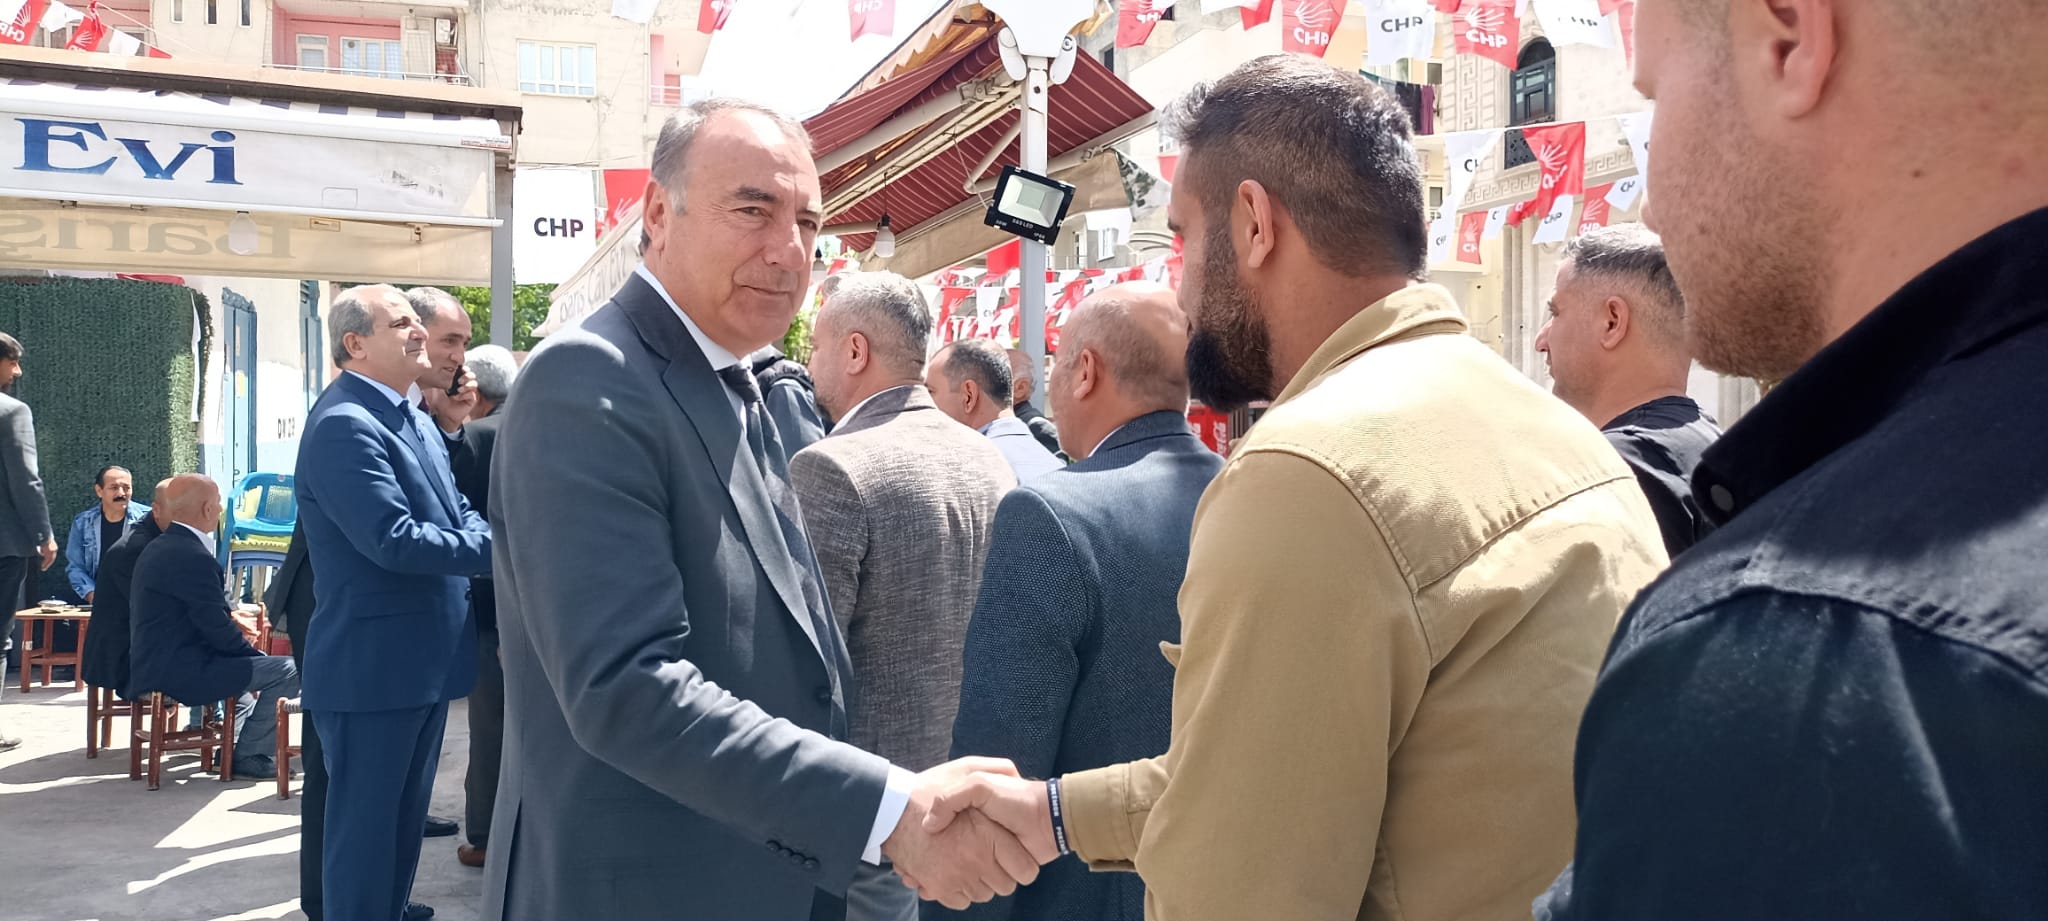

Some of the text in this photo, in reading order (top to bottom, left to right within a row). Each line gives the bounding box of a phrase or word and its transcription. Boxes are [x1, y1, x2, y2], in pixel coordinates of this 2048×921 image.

[1381, 16, 1423, 32] CHP
[1293, 27, 1330, 46] CHP
[1465, 29, 1508, 48] CHP
[13, 117, 244, 186] Evi
[534, 217, 584, 238] CHP
